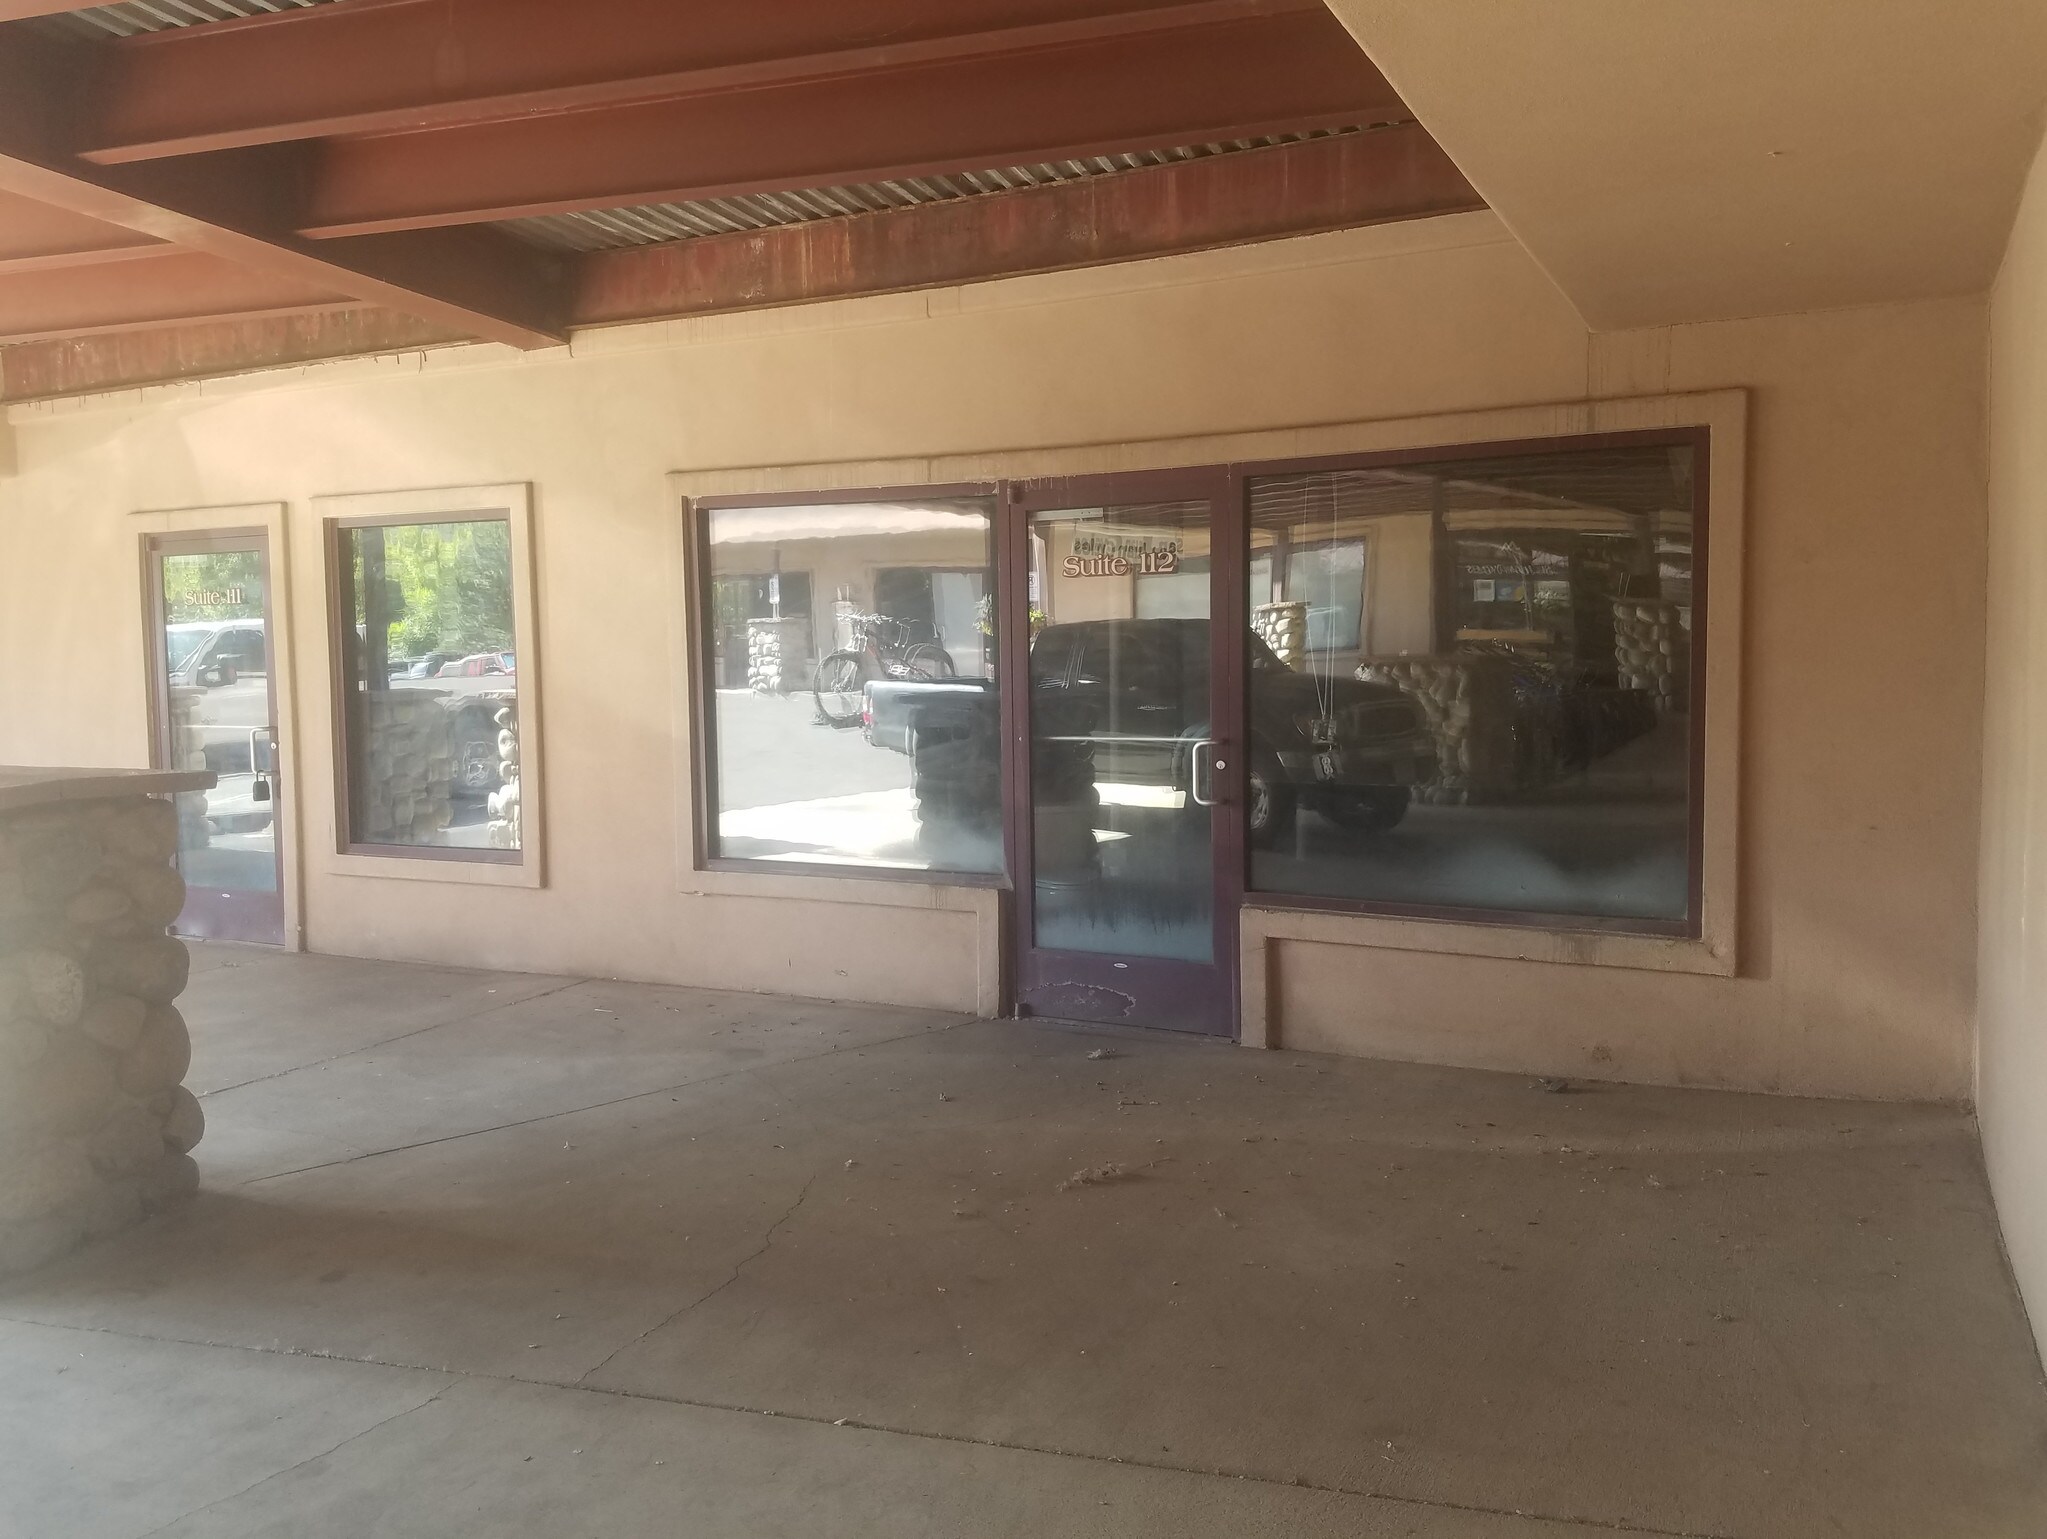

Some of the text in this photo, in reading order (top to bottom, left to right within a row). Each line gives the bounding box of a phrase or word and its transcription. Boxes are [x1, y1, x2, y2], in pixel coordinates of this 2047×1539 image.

[1062, 552, 1177, 577] Suite 112
[184, 588, 220, 606] Suite
